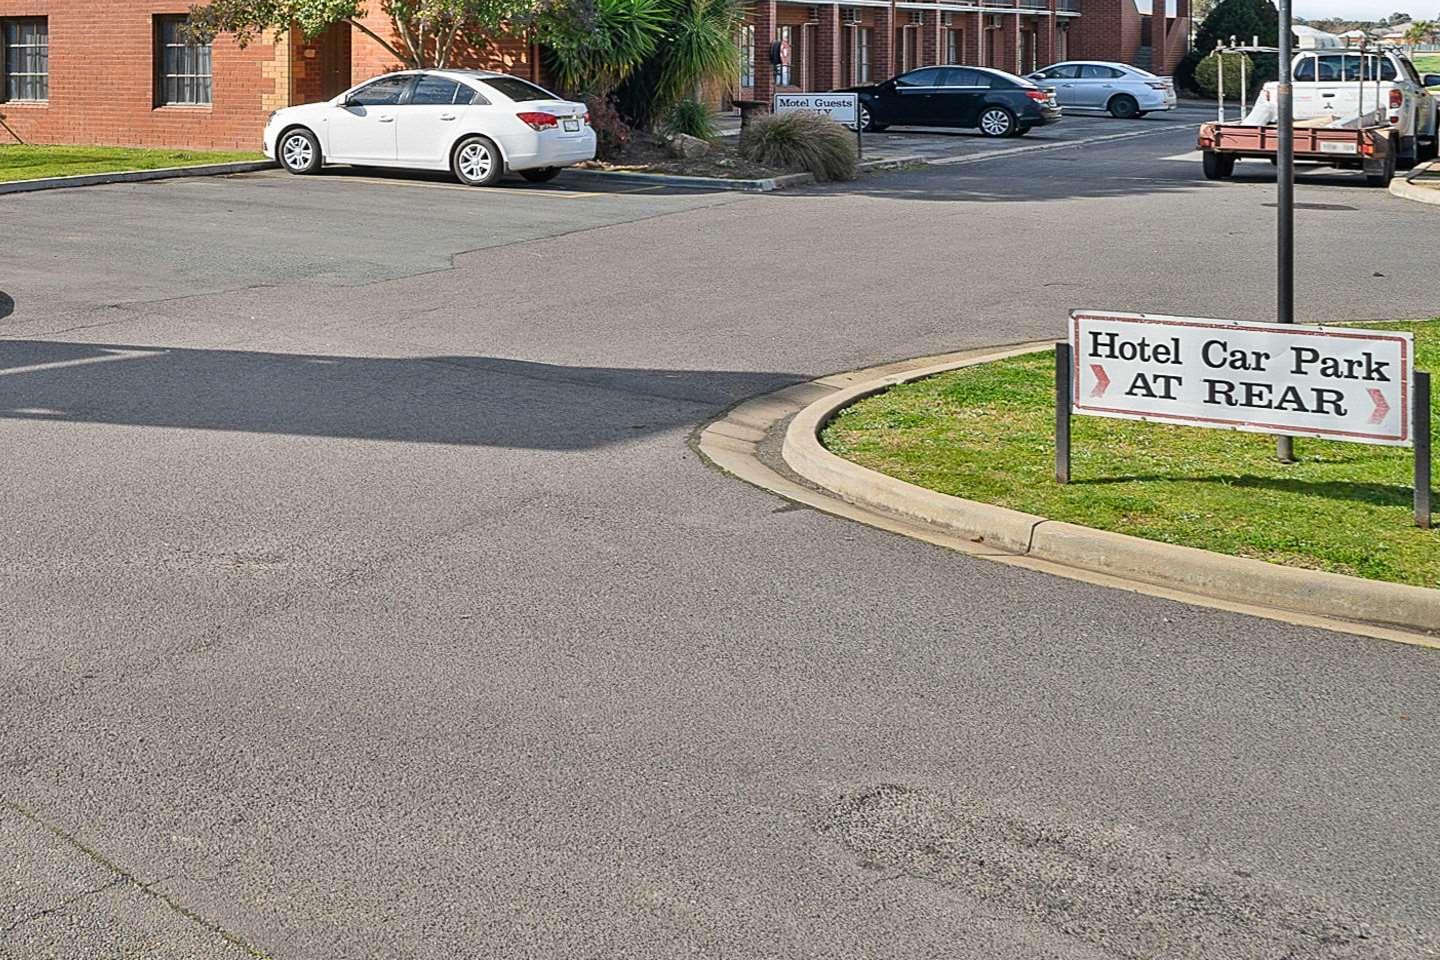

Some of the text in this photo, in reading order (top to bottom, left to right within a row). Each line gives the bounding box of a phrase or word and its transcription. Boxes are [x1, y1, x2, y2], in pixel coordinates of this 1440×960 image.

[779, 98, 853, 108] Motel Guests
[1088, 331, 1391, 383] Hotel Car Park
[1124, 372, 1348, 417] AT REAR
